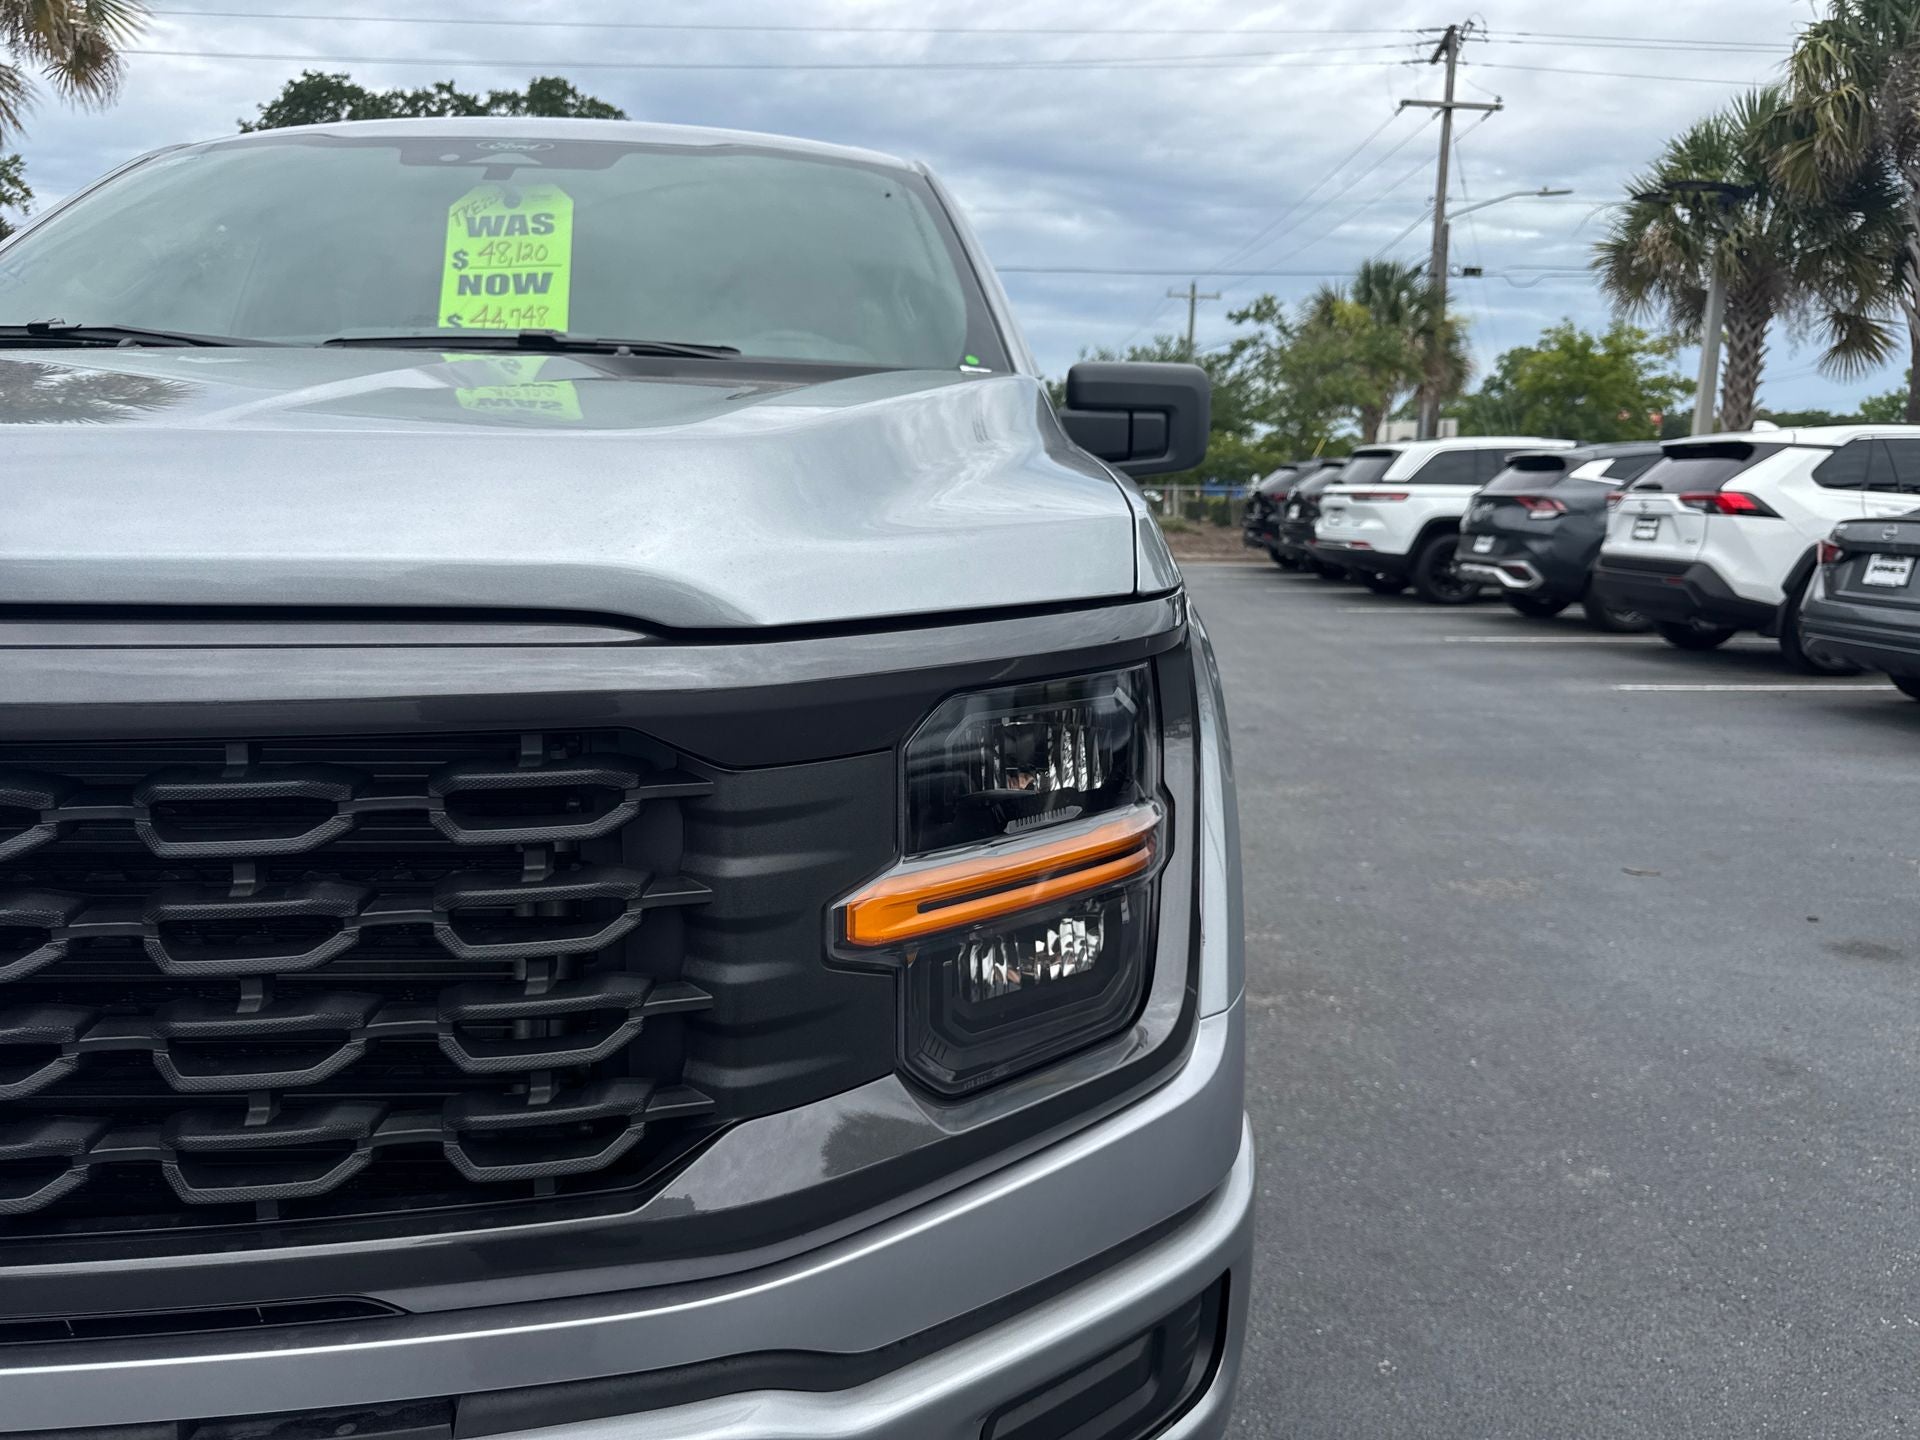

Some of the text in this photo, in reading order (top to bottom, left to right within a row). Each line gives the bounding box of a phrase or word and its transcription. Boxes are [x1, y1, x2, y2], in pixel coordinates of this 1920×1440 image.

[467, 213, 555, 237] WAS
[452, 241, 549, 270] $ 48,120
[458, 272, 553, 295] NOW
[469, 304, 549, 329] 44,748
